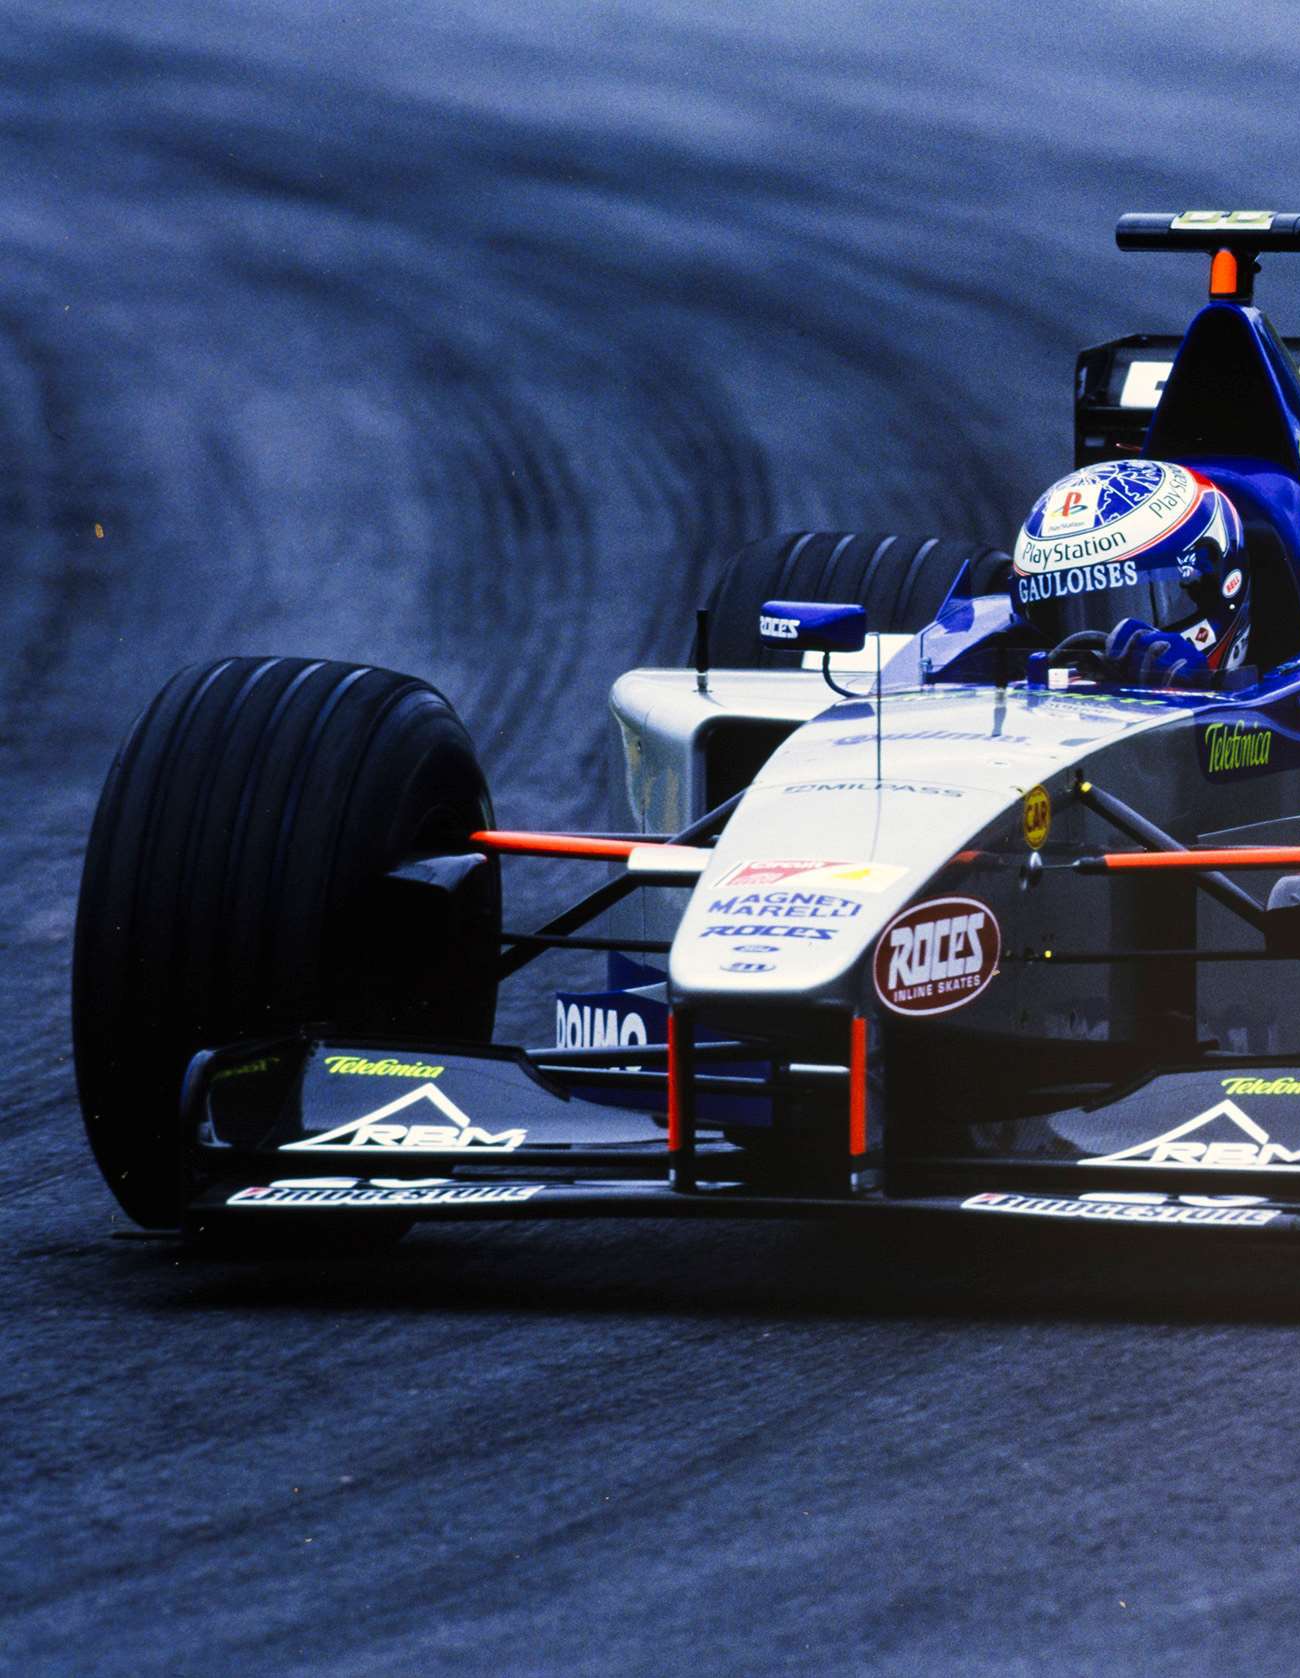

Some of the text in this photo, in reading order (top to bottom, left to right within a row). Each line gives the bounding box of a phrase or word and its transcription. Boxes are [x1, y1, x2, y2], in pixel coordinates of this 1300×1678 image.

[1022, 530, 1127, 570] PlayStation
[1018, 560, 1138, 604] GAULOISES
[698, 924, 838, 940] ROCES
[888, 911, 985, 990] ROCES
[893, 974, 981, 1002] INLINE SKATES
